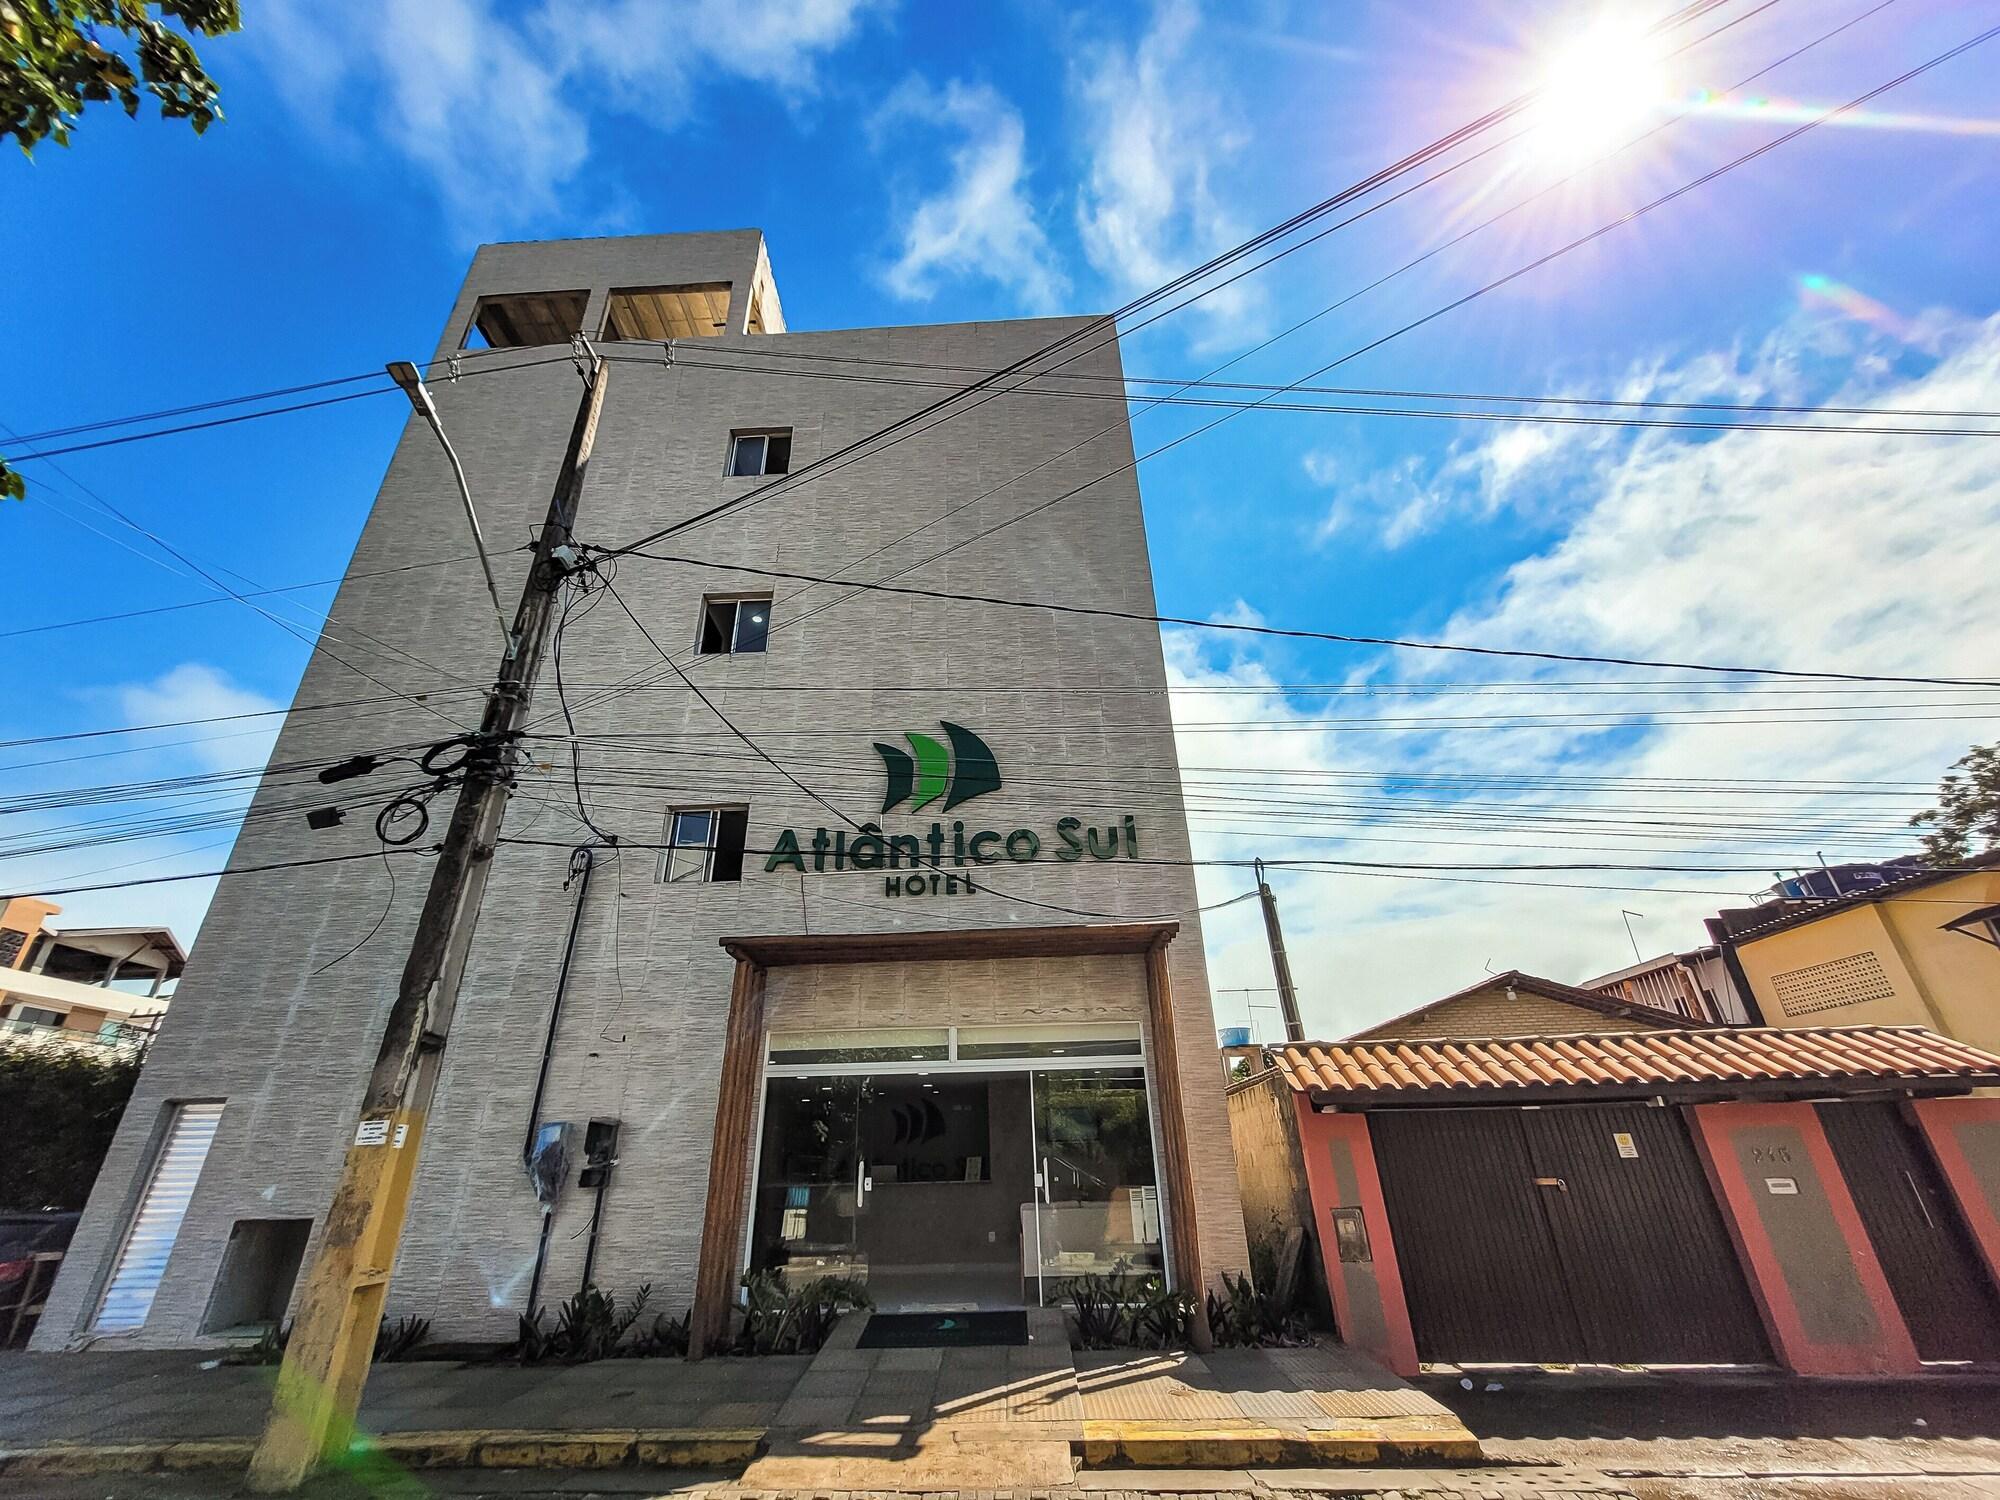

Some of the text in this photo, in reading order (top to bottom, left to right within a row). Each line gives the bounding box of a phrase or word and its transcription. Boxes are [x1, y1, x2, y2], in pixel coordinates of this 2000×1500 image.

[764, 815, 1138, 873] Atlântico Sul
[885, 873, 977, 897] HOTEL
